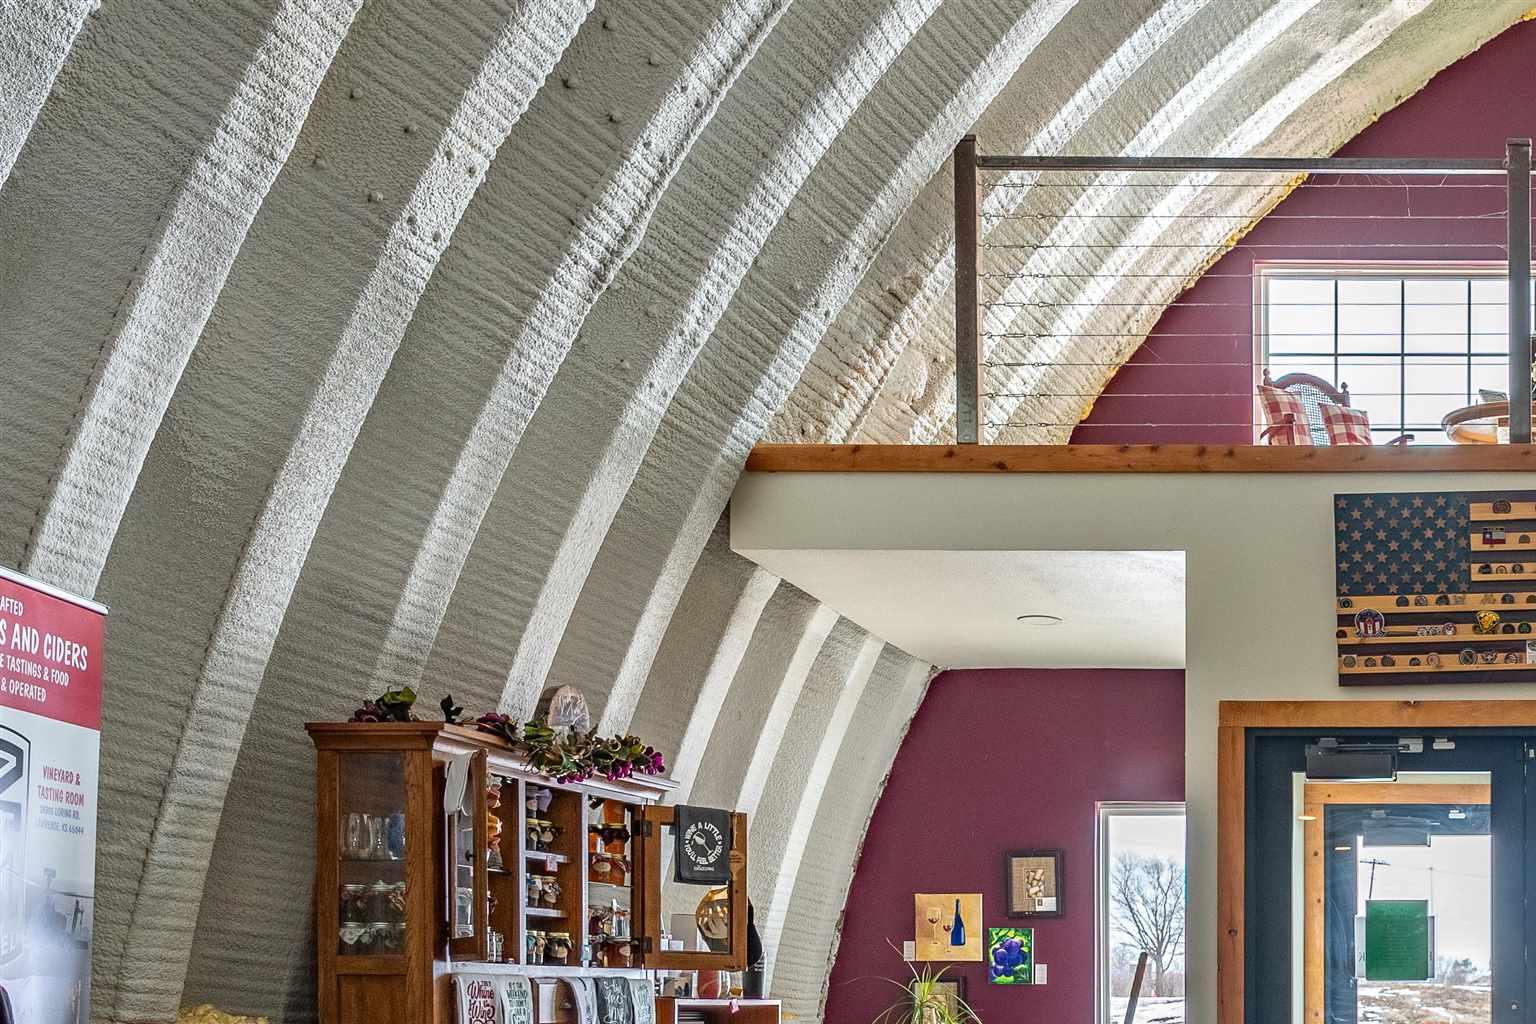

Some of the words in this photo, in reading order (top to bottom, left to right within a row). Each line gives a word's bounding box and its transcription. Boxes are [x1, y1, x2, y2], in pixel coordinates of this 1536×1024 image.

[11, 623, 39, 654] AND
[44, 633, 88, 671] CIDERS
[7, 655, 41, 679] TASTINGS
[43, 667, 49, 681] &
[51, 669, 69, 686] FOOD
[9, 680, 46, 702] OPERATED
[43, 765, 74, 784] VINEYARD
[38, 785, 63, 802] TASTING
[66, 791, 84, 806] ROOM
[704, 822, 722, 840] LITTLE
[708, 845, 723, 863] BETTER
